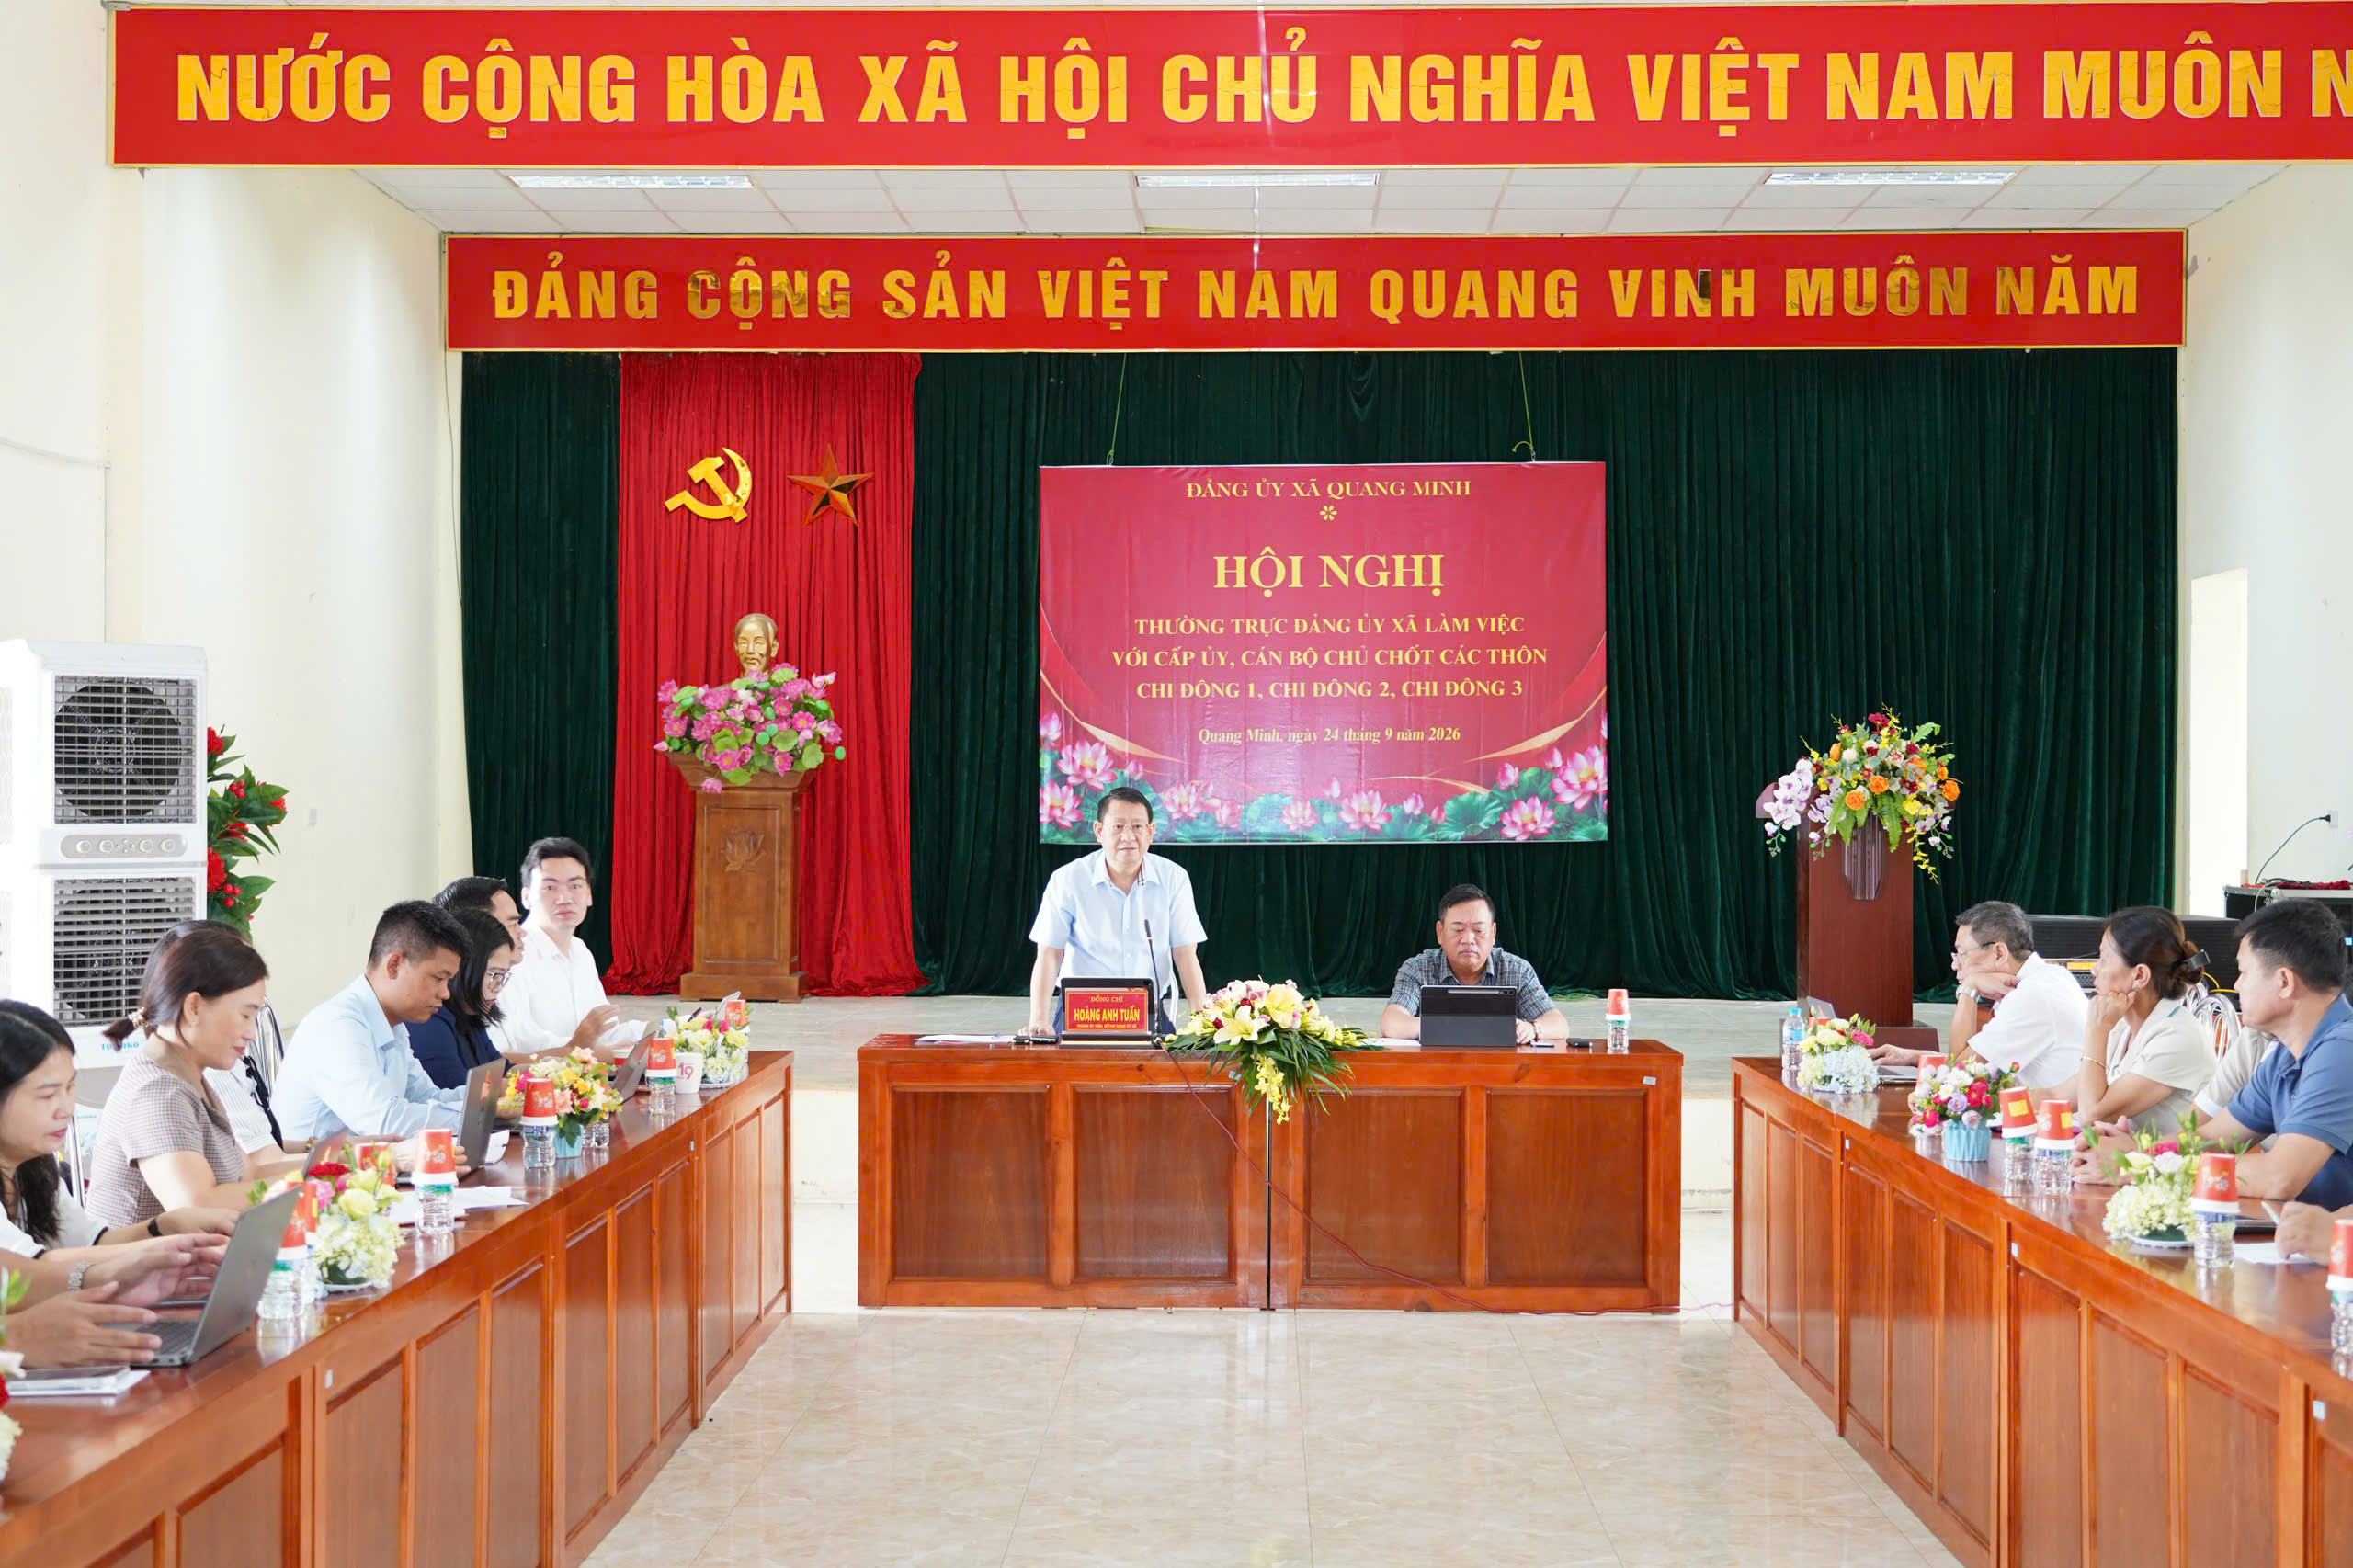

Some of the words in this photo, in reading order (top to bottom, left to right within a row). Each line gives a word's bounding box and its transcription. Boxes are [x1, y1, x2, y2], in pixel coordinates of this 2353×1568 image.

[178, 32, 390, 122] NƯỚC
[423, 39, 634, 138] CỘNG
[667, 37, 824, 123] HÒA
[858, 40, 967, 122] XÃ
[1000, 37, 1127, 139] HỘI
[1163, 27, 1317, 124] CHỦ
[1350, 38, 1595, 122] NGHĨA
[1627, 37, 1799, 136] VIỆT
[1827, 52, 2012, 119] NAM
[2044, 31, 2281, 119] MUÔN
[493, 251, 657, 319] ĐẢNG
[688, 256, 850, 329] CỘNG
[883, 250, 1005, 318] SẢN
[1038, 257, 1168, 330] VIỆT
[1199, 265, 1336, 318] NAM
[1370, 269, 1577, 324] QUANG
[1609, 269, 1754, 317] VINH
[1786, 255, 1967, 316] MUÔN
[1996, 254, 2137, 314] NĂM
[1188, 479, 1247, 497] ĐẢNG
[1256, 478, 1284, 496] ỦY
[1291, 479, 1320, 496] XÃ
[1327, 482, 1404, 499] QUANG
[1414, 481, 1470, 495] MINH
[1213, 546, 1303, 597] HỘI
[1319, 555, 1444, 596] NGHỊ
[1135, 615, 1224, 634] THƯỜNG
[1231, 618, 1287, 637] TRỰC
[1294, 614, 1350, 633] ĐẢNG
[1358, 614, 1384, 632] ỦY
[1392, 615, 1417, 632] XÃ
[1426, 613, 1469, 632] LÀM
[1476, 614, 1524, 634] VIỆC
[1112, 647, 1147, 666] VỚI
[1154, 646, 1195, 665] CẤP
[1201, 646, 1234, 668] ỦY,
[1242, 646, 1281, 665] CÁN
[1290, 647, 1318, 668] BỘ
[1324, 645, 1368, 665] CHỦ
[1375, 645, 1434, 665] CHỐT
[1440, 645, 1480, 664] CÁC
[1486, 645, 1546, 664] THÔN
[1137, 684, 1172, 698] CHI
[1181, 680, 1239, 698] ĐÔNG
[1249, 683, 1263, 699] 1,
[1269, 683, 1305, 698] CHI
[1313, 679, 1371, 697] ĐÔNG
[1380, 682, 1395, 699] 2,
[1402, 681, 1438, 697] CHI
[1446, 678, 1504, 696] ĐÔNG
[1512, 681, 1522, 695] 3
[1199, 729, 1242, 745] Quang
[1288, 729, 1317, 746] ngày
[1324, 728, 1338, 741] 24
[1344, 728, 1380, 744] tháng
[1385, 728, 1392, 740] 9
[1397, 730, 1424, 740] năm
[1428, 728, 1460, 740] 2026
[1074, 1006, 1101, 1021] HOÀNG
[1102, 1008, 1119, 1021] ANH
[678, 1062, 694, 1080] 19
